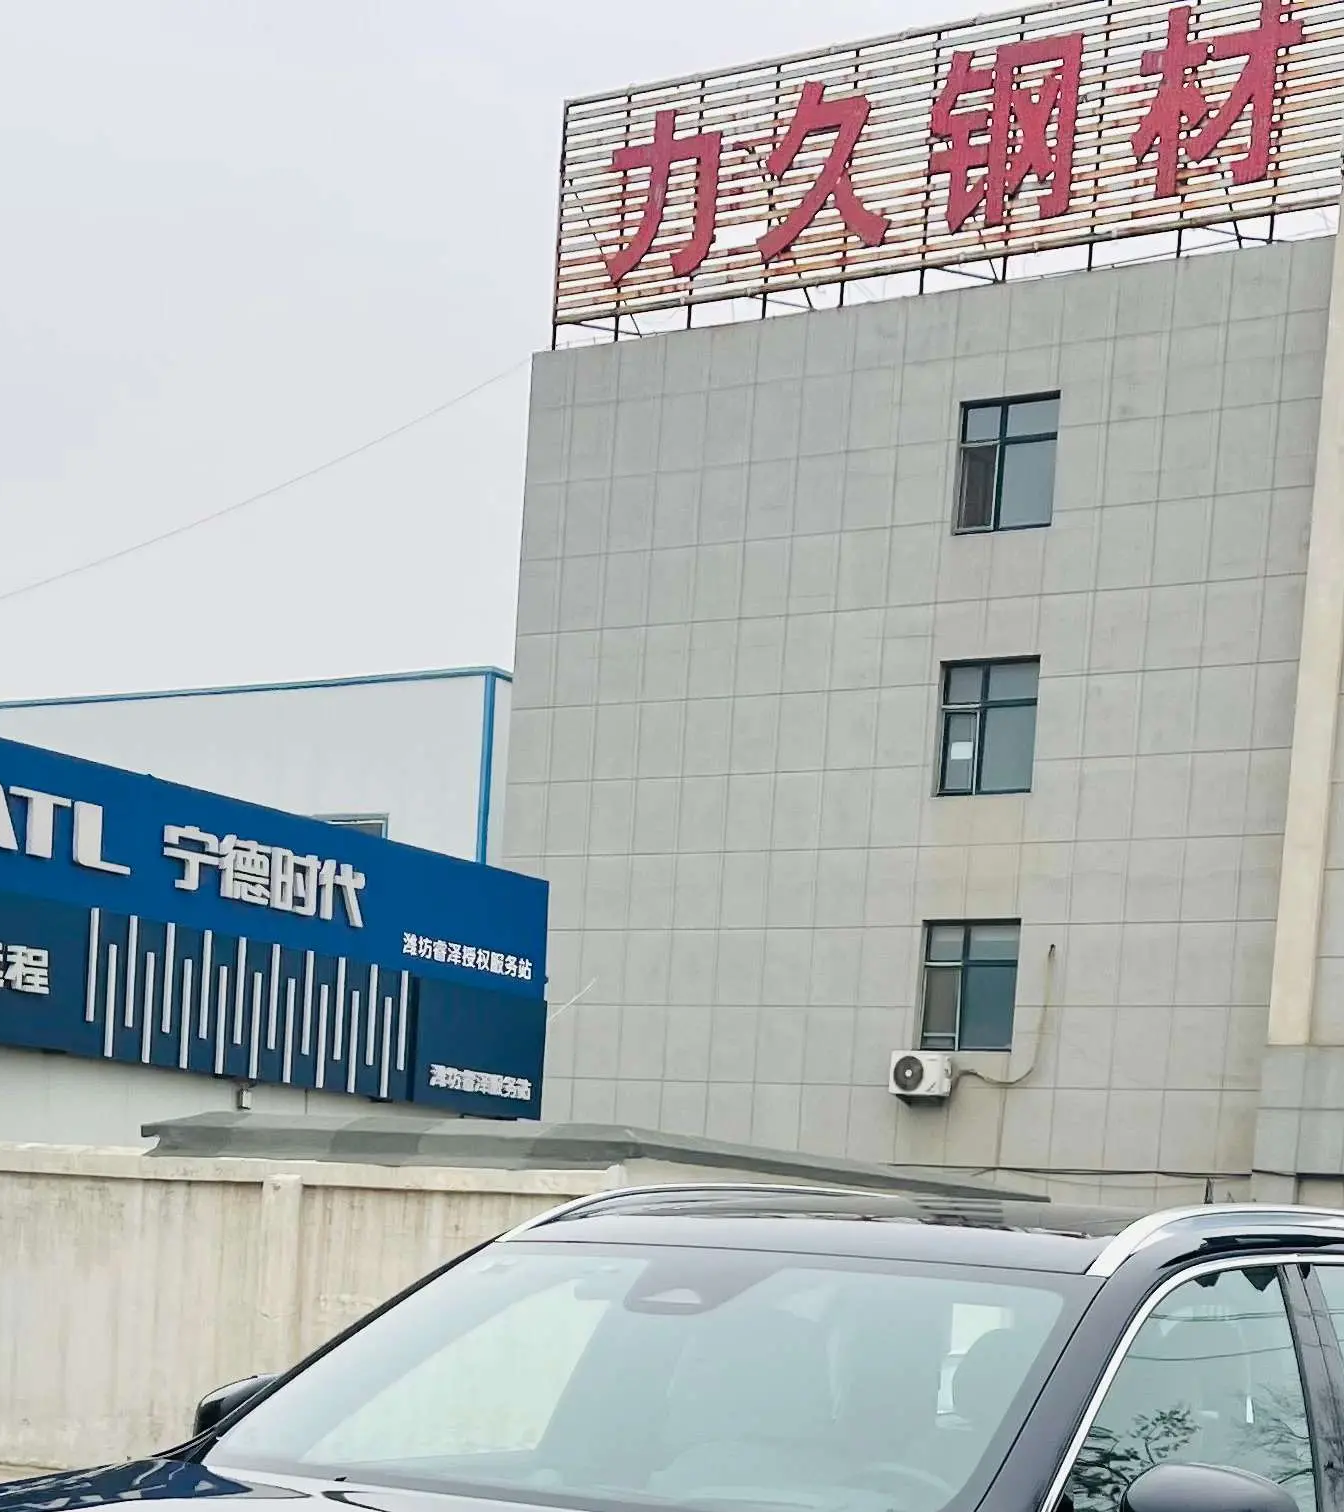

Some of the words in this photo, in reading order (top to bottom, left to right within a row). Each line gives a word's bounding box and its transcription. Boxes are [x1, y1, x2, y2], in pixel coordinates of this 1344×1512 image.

[604, 0, 1307, 285] 力久钢材
[163, 825, 365, 928] 宁德时代
